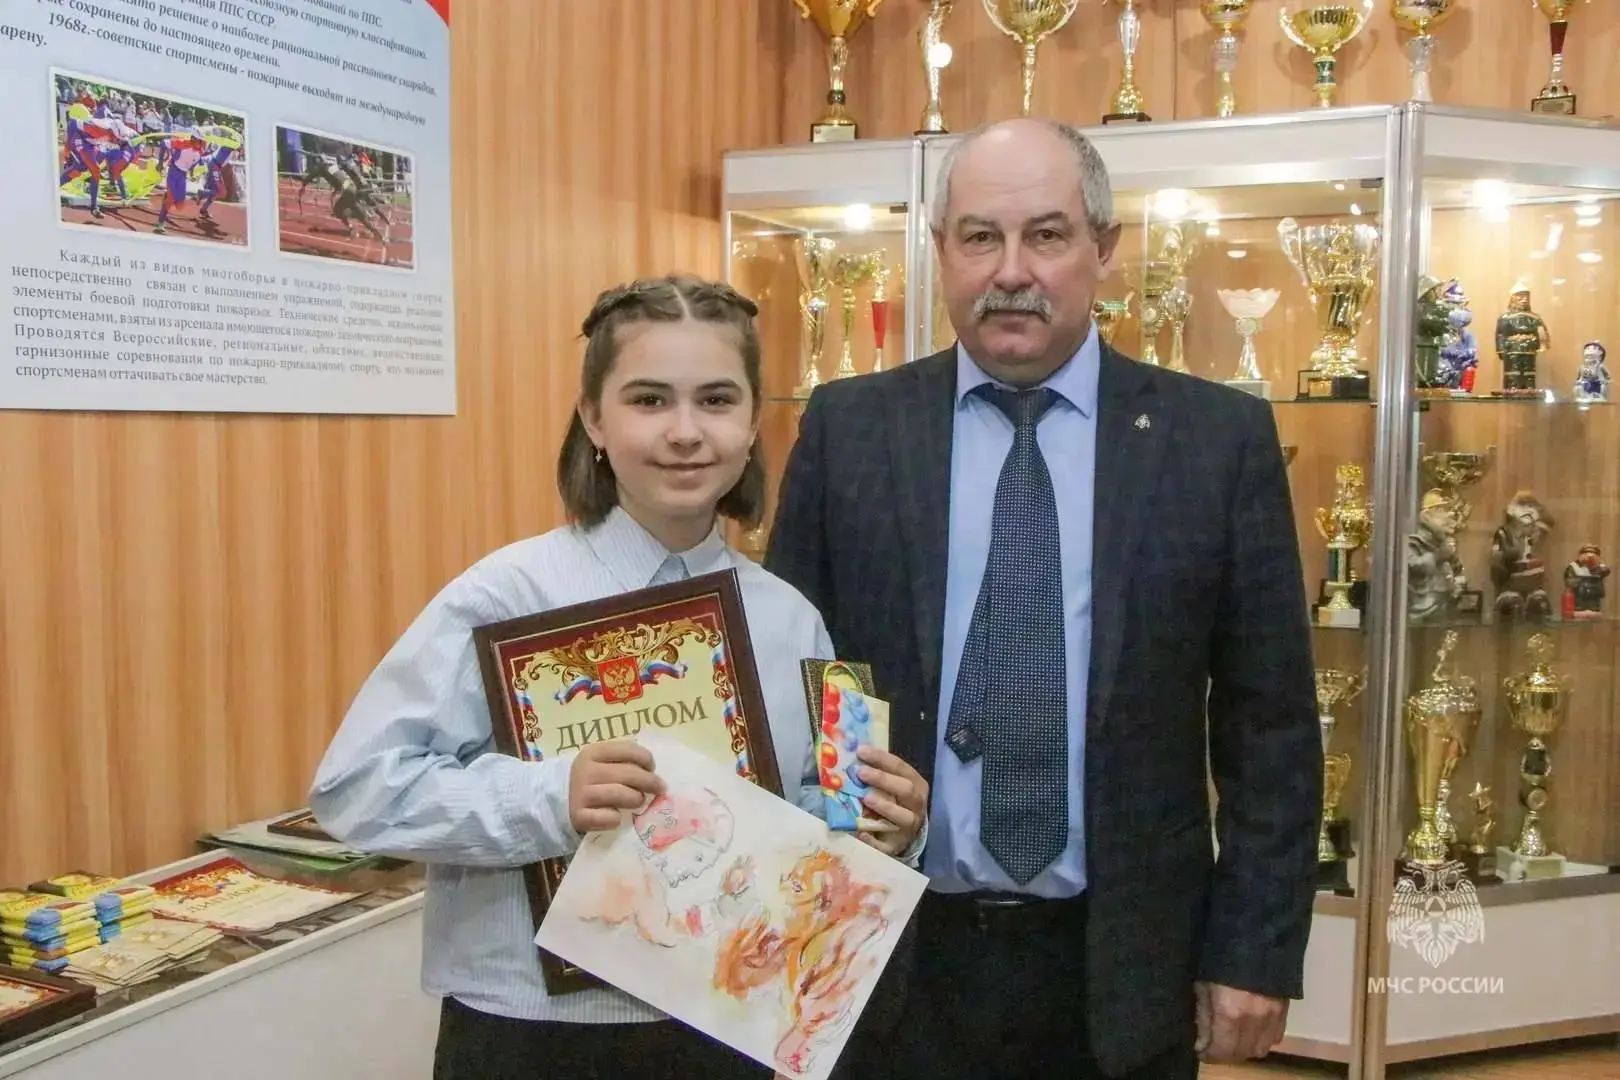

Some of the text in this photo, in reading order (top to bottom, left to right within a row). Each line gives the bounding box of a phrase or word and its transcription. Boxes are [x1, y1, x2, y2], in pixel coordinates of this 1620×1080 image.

[219, 1, 245, 19] ППС
[300, 11, 360, 37] спортивную
[0, 24, 48, 47] арену.
[69, 0, 281, 68] сохранены до настоящего времени.
[159, 4, 209, 28] решение
[211, 20, 219, 30] о
[221, 23, 270, 46] наиболее
[272, 39, 341, 68] рациональной
[165, 47, 238, 75] спортсмены
[247, 69, 300, 92] пожарные
[302, 83, 343, 104] выходят
[345, 96, 357, 106] на
[59, 248, 122, 268] Каждый
[129, 259, 147, 271] из
[153, 261, 195, 276] видов
[201, 267, 277, 285] многоборья
[11, 265, 133, 288] непосредственно
[146, 279, 187, 293] связан
[192, 283, 199, 294] с
[204, 285, 279, 302] выполнением
[12, 286, 83, 302] элементы
[89, 290, 136, 307] боевой
[142, 297, 211, 315] подготовки
[13, 305, 118, 325] спортсменами,
[119, 314, 157, 326] взяты
[159, 316, 173, 328] из
[174, 319, 225, 333] арсенала
[14, 323, 106, 341] Проводятся
[113, 329, 218, 349] Всероссийские,
[15, 345, 111, 361] гарнизонные
[116, 350, 203, 366] соревнования
[208, 356, 225, 366] по
[15, 365, 268, 387] спортсменам оттачивать свое мастерство.
[556, 696, 709, 755] ДИПЛОМ
